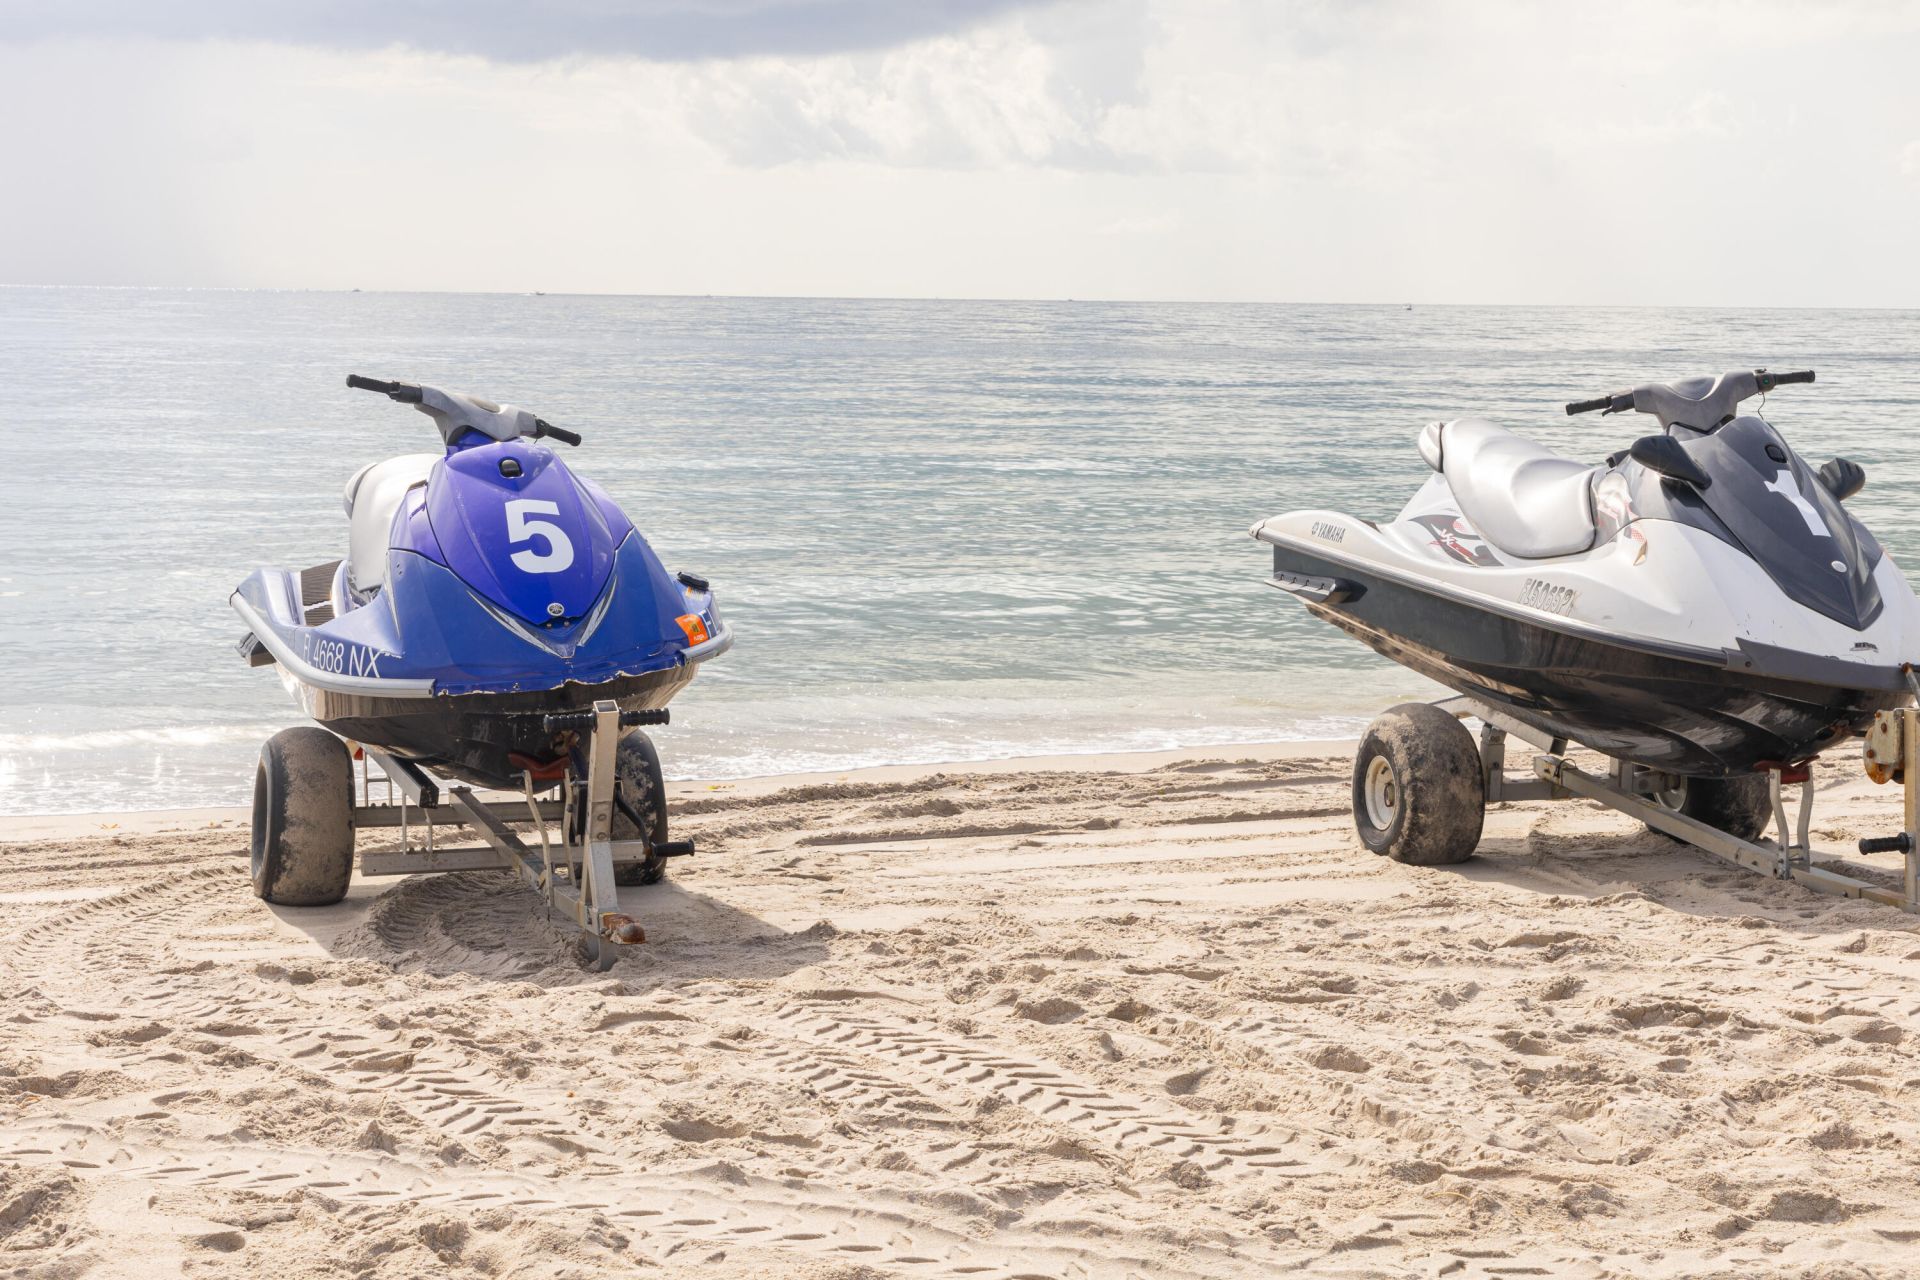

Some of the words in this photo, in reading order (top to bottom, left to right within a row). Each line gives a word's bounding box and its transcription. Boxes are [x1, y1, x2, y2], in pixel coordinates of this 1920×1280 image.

[1763, 469, 1831, 538] 1
[505, 499, 574, 574] 5
[1317, 522, 1346, 544] YAMAHA
[313, 639, 345, 674] 4668
[349, 645, 380, 678] NX
